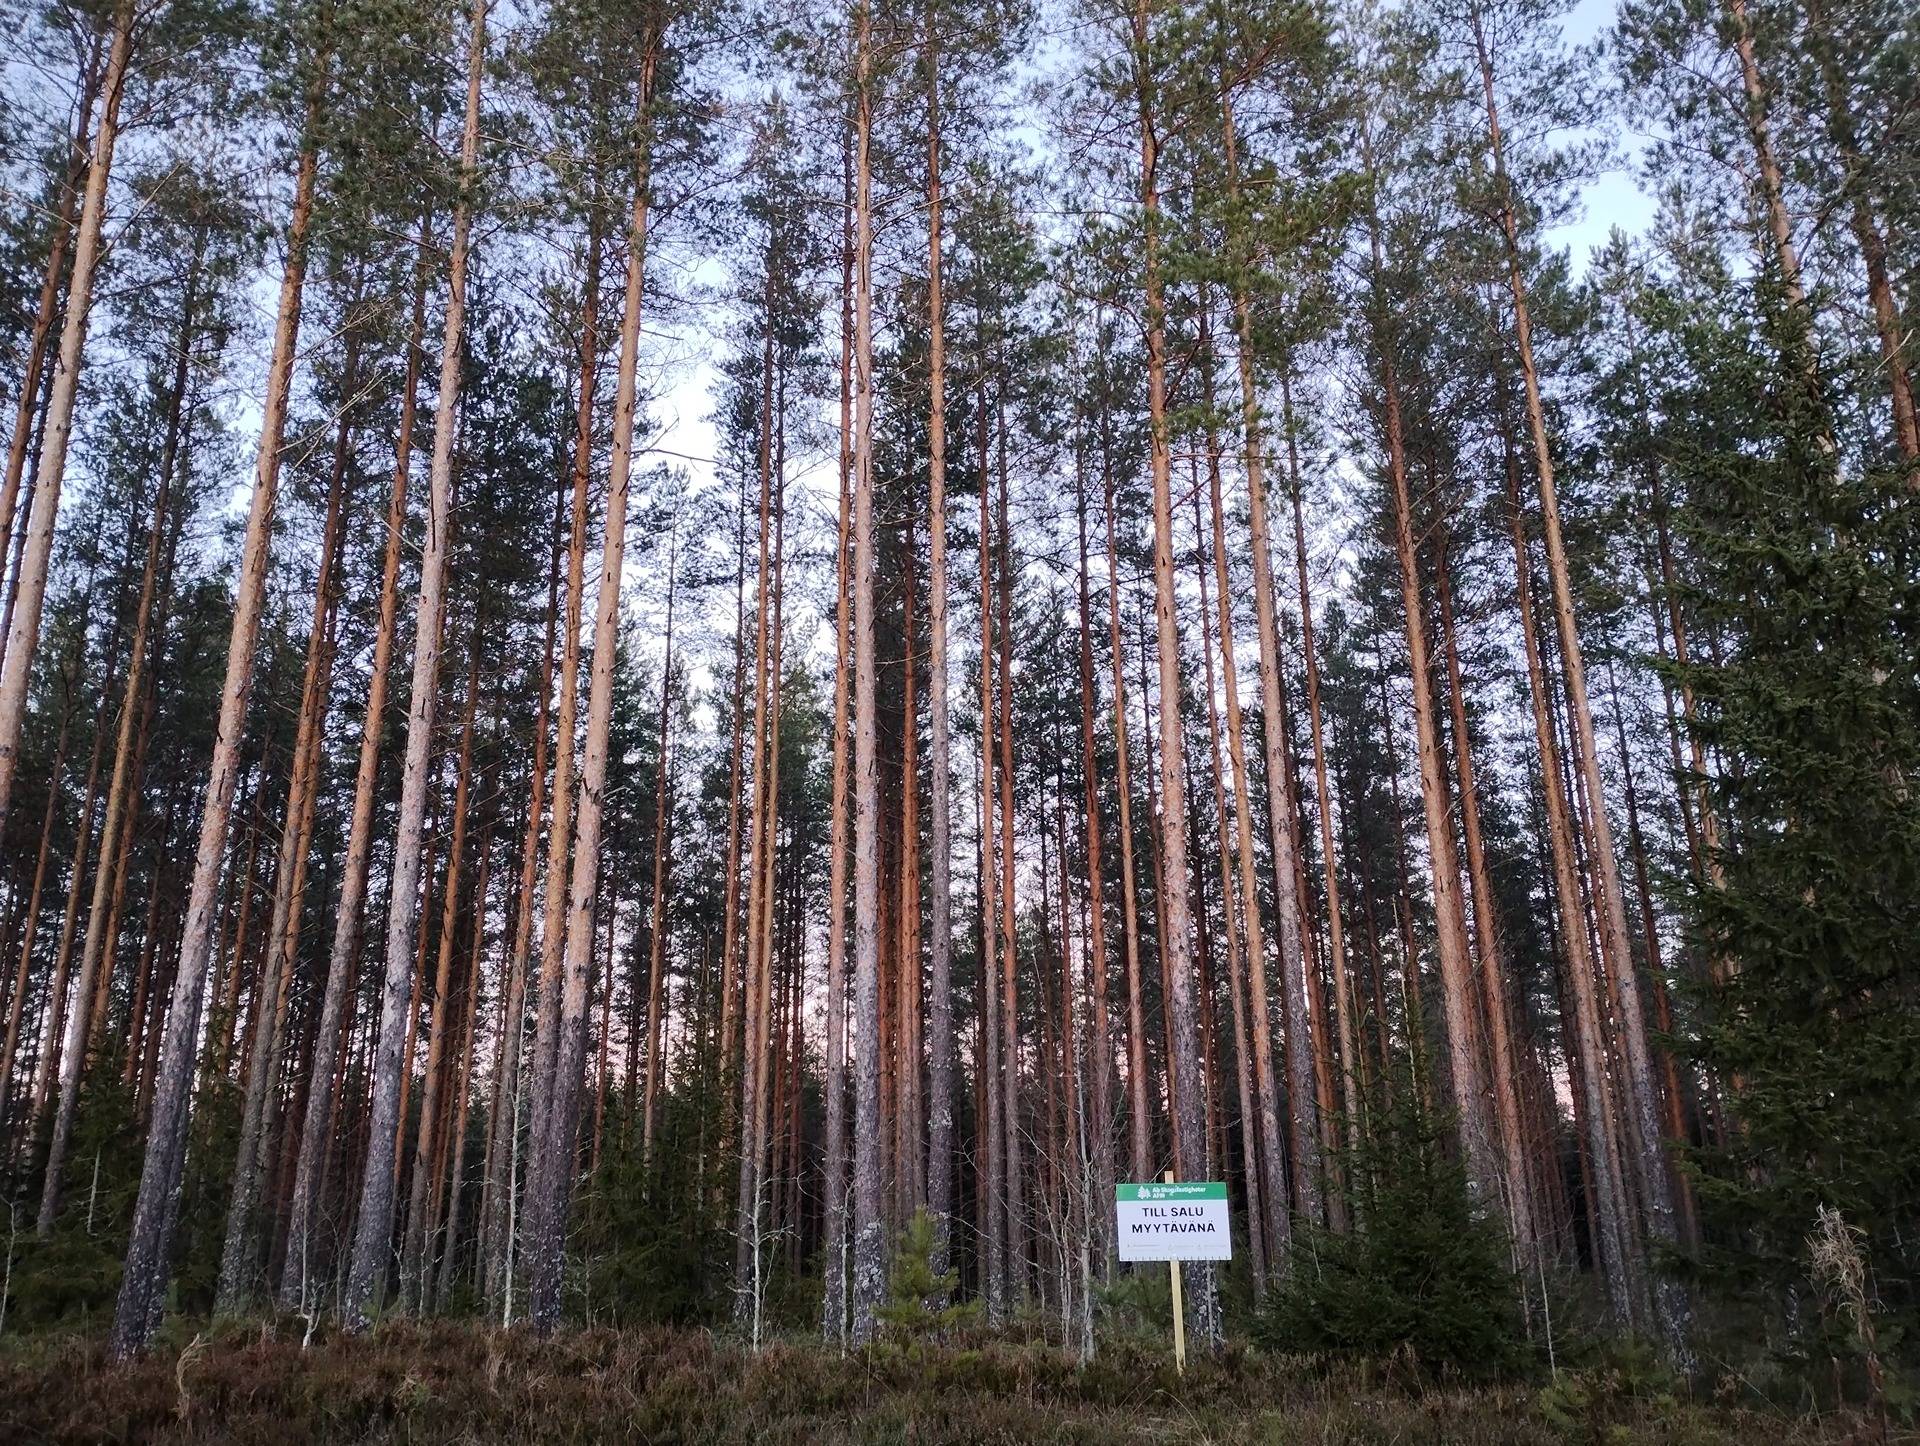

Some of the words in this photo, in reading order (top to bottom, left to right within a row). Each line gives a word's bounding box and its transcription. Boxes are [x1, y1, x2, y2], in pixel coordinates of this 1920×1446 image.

[1141, 1207, 1167, 1217] TILL
[1170, 1206, 1204, 1217] SALU
[1131, 1219, 1216, 1233] MYYTÄVÄNÄ
